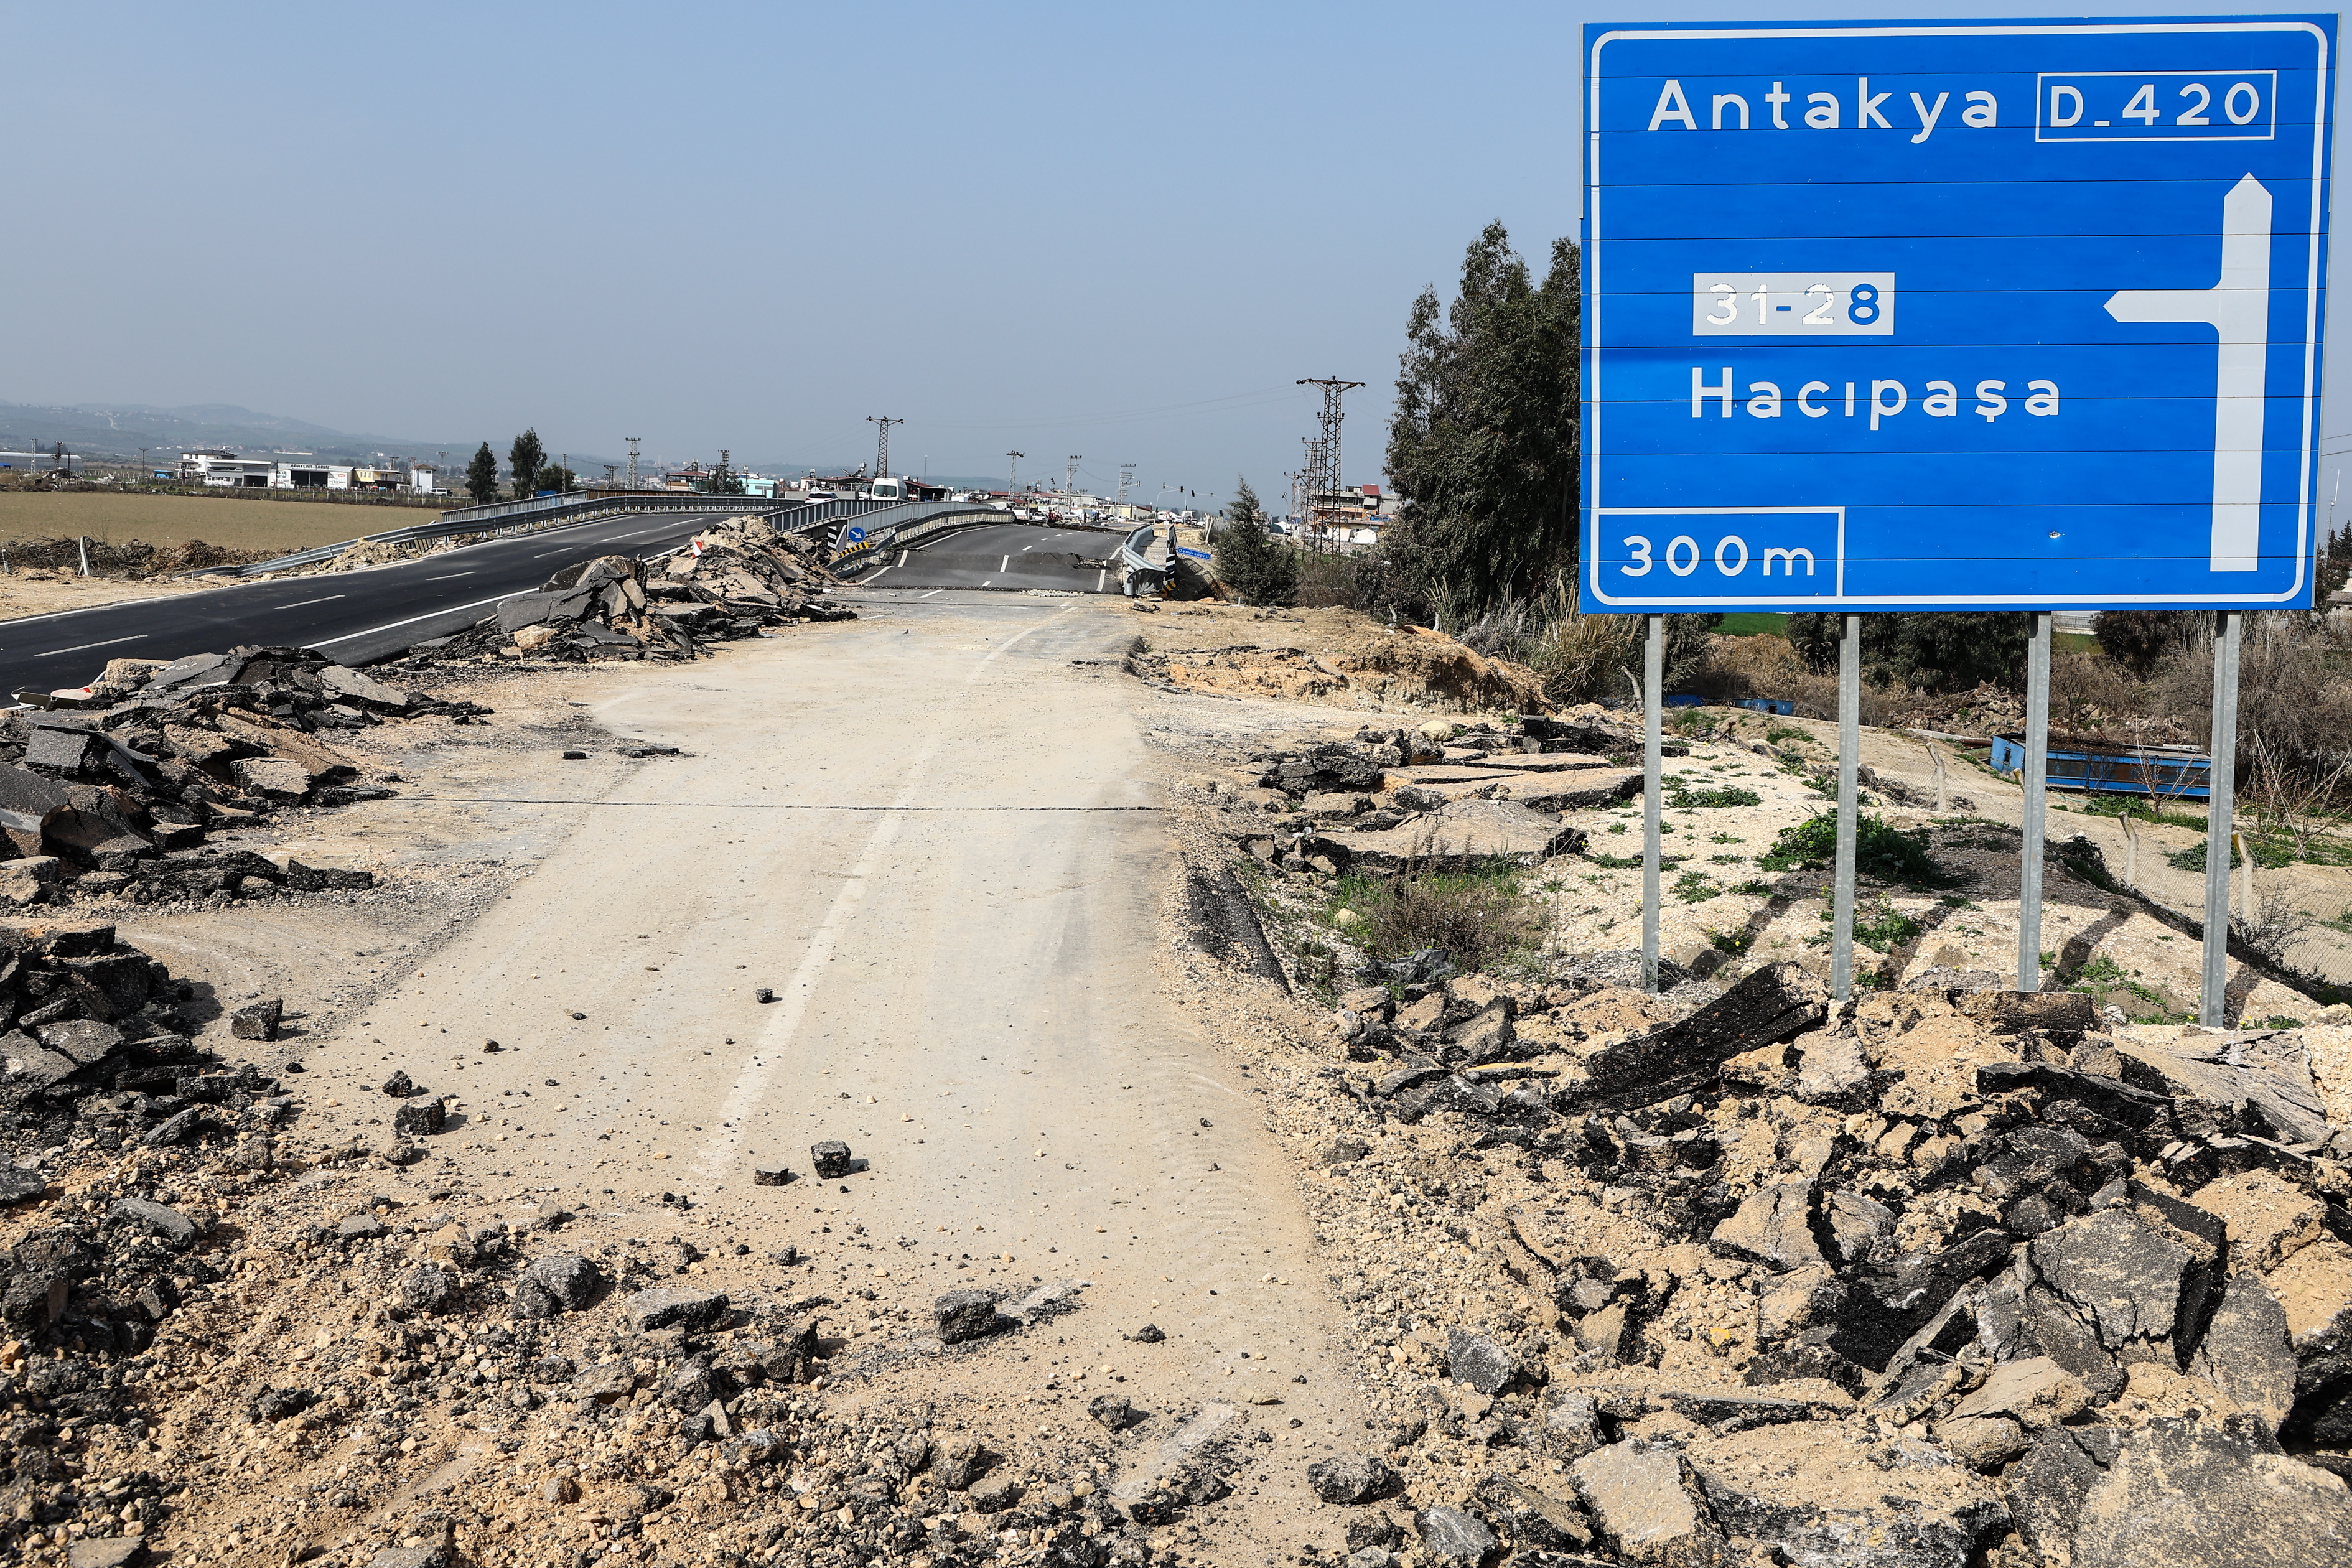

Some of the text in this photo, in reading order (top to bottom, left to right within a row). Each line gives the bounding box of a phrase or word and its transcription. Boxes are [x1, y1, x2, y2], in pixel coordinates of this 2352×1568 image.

[1648, 77, 1997, 144] Antakya
[1706, 283, 1880, 325] 31-28
[1691, 366, 2060, 431] Hacıpaşa
